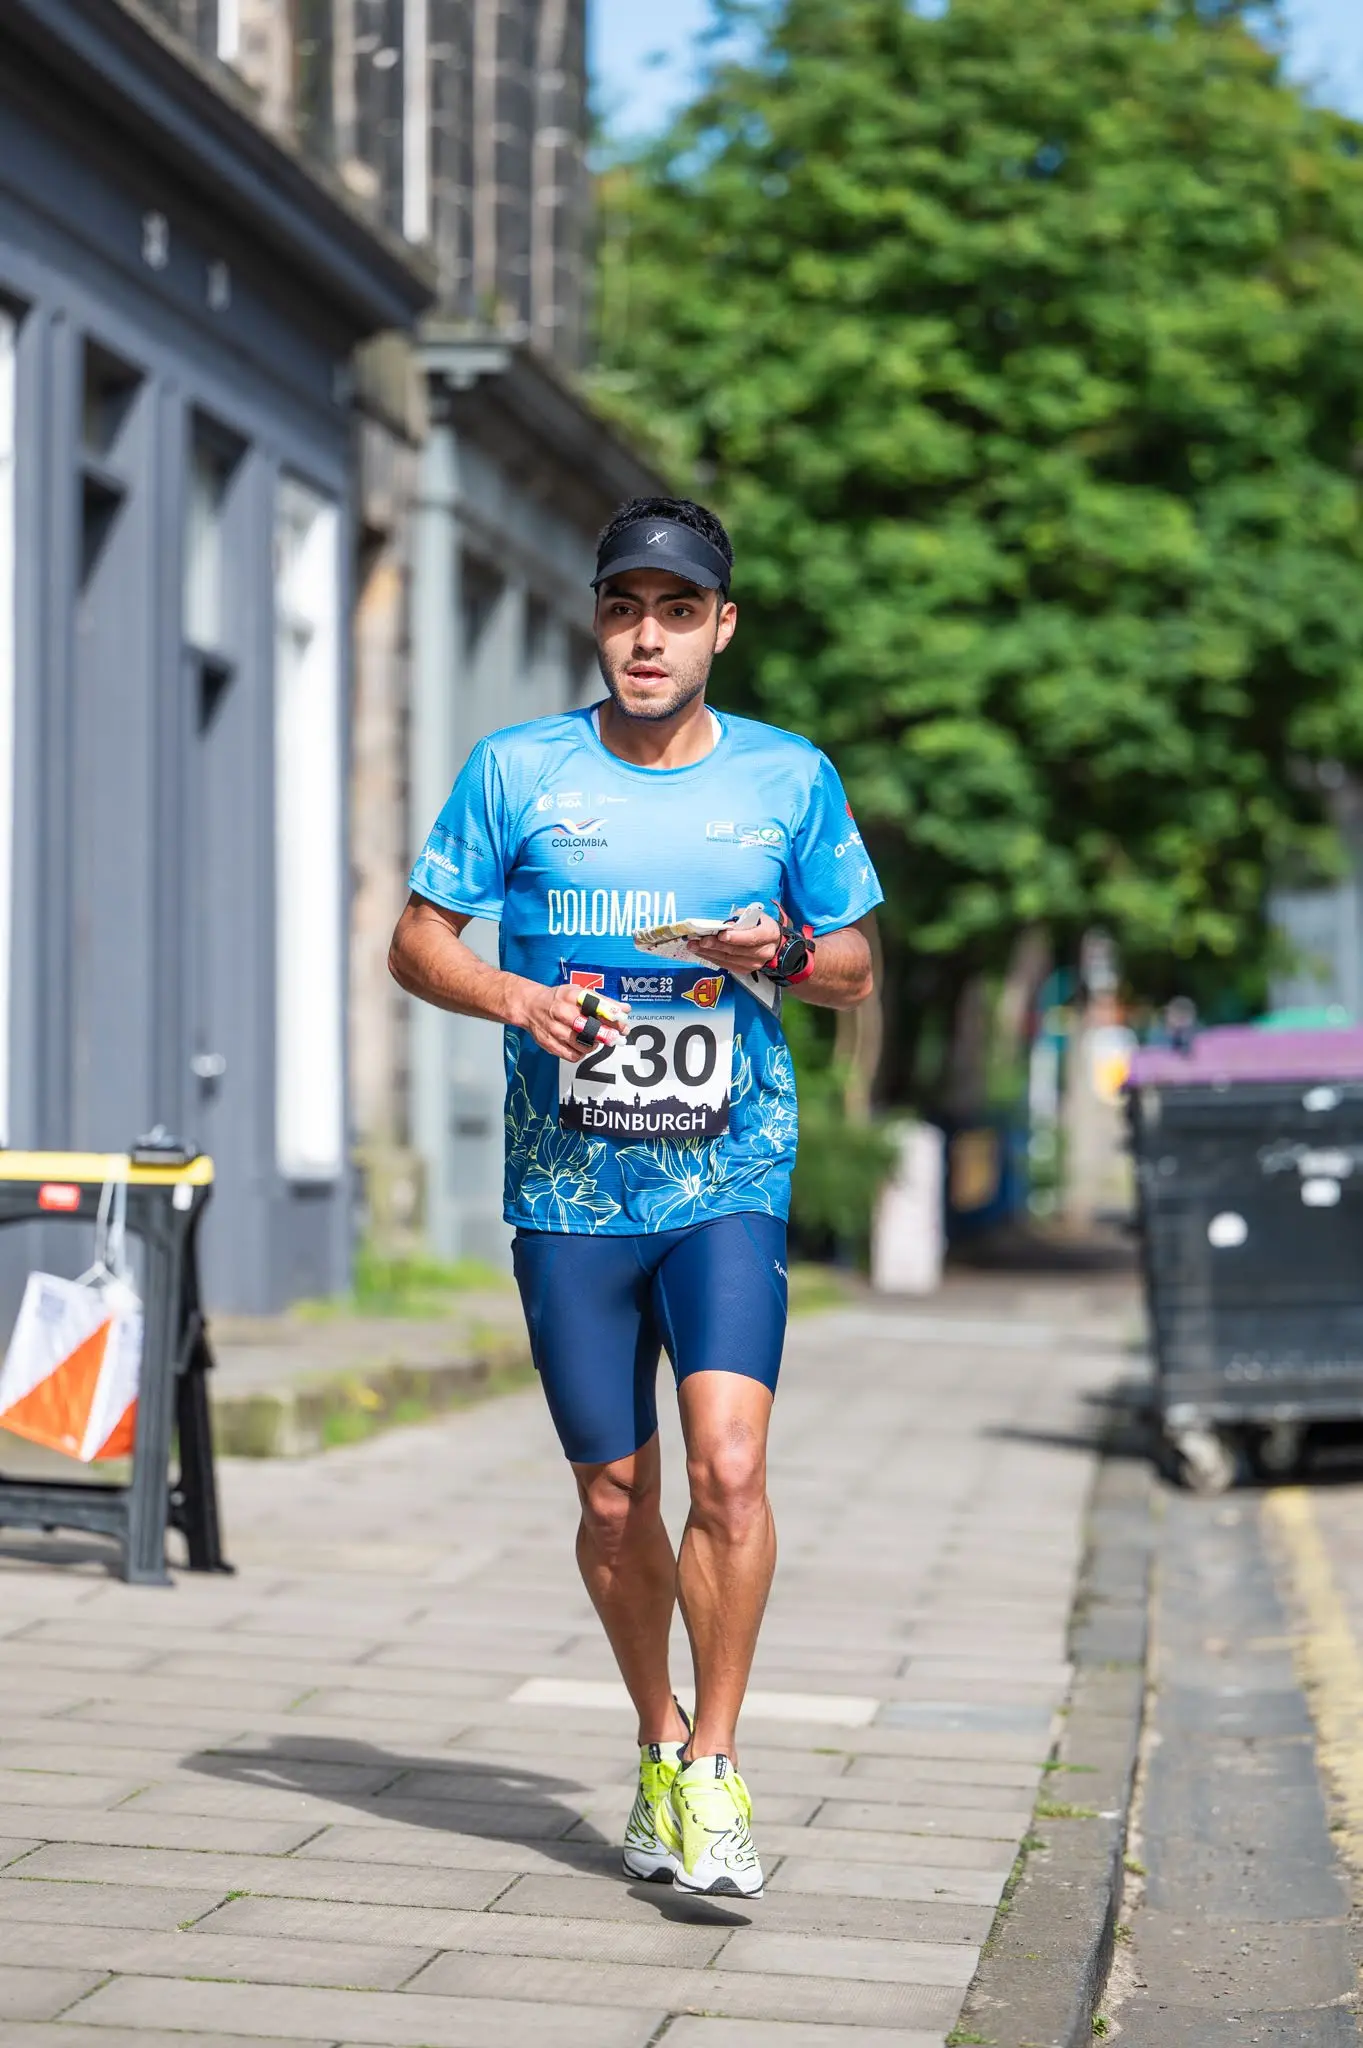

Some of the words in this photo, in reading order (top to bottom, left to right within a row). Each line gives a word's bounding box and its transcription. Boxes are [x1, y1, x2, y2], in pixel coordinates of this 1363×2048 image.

[551, 838, 608, 848] COLOMBIA
[547, 889, 678, 937] COLOMBIA
[621, 976, 659, 993] WOC
[659, 977, 673, 985] 20
[659, 985, 673, 993] 24
[575, 1024, 717, 1087] 230
[582, 1107, 706, 1131] EDINBURGH
